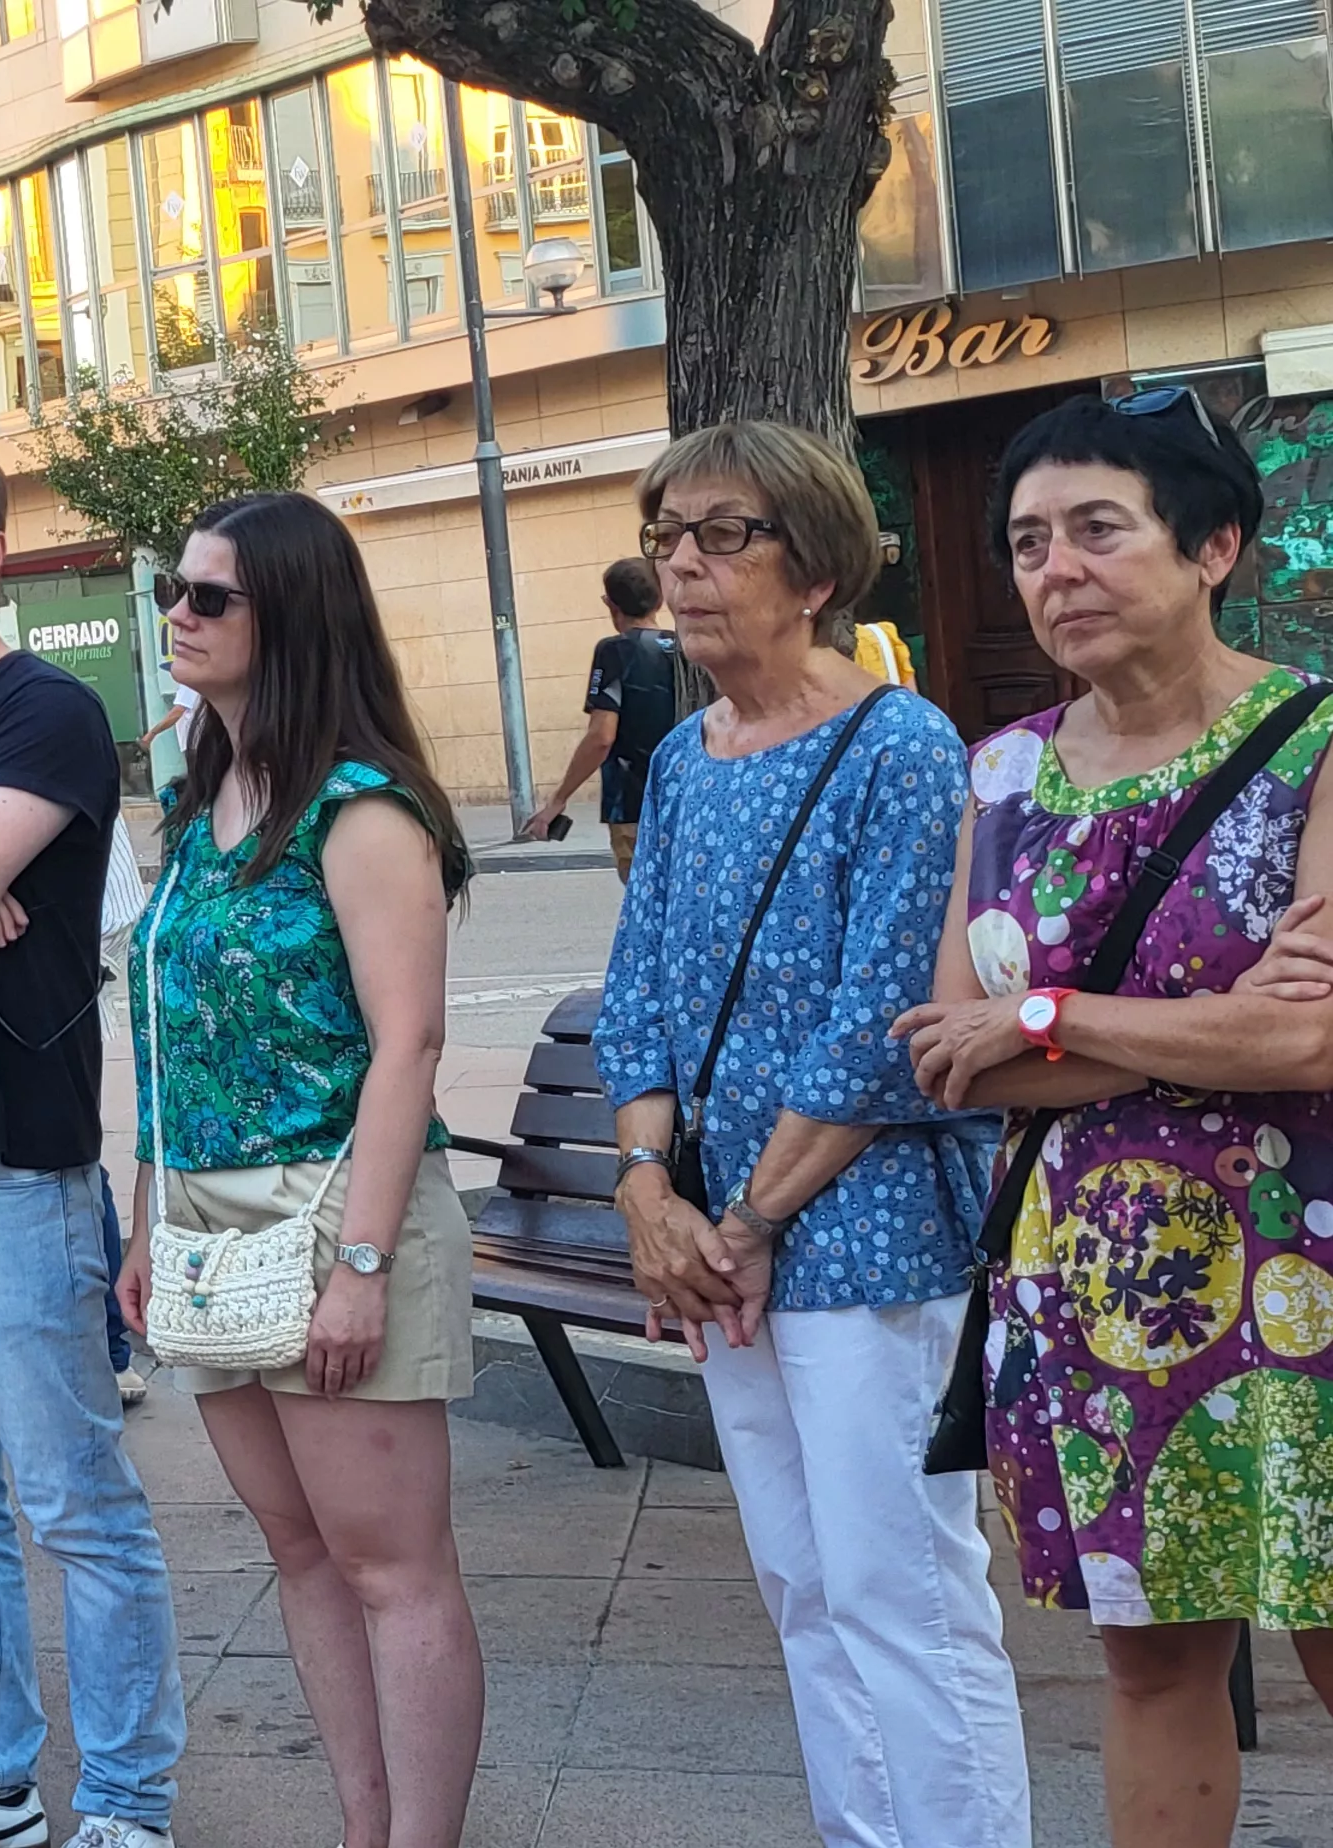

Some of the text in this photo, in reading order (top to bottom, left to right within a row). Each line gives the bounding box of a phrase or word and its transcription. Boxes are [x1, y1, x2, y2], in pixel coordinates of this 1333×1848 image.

[852, 303, 1053, 384] Bar
[544, 459, 582, 478] ANITA
[28, 618, 120, 652] CERRADO
[41, 646, 112, 668] por reformas
